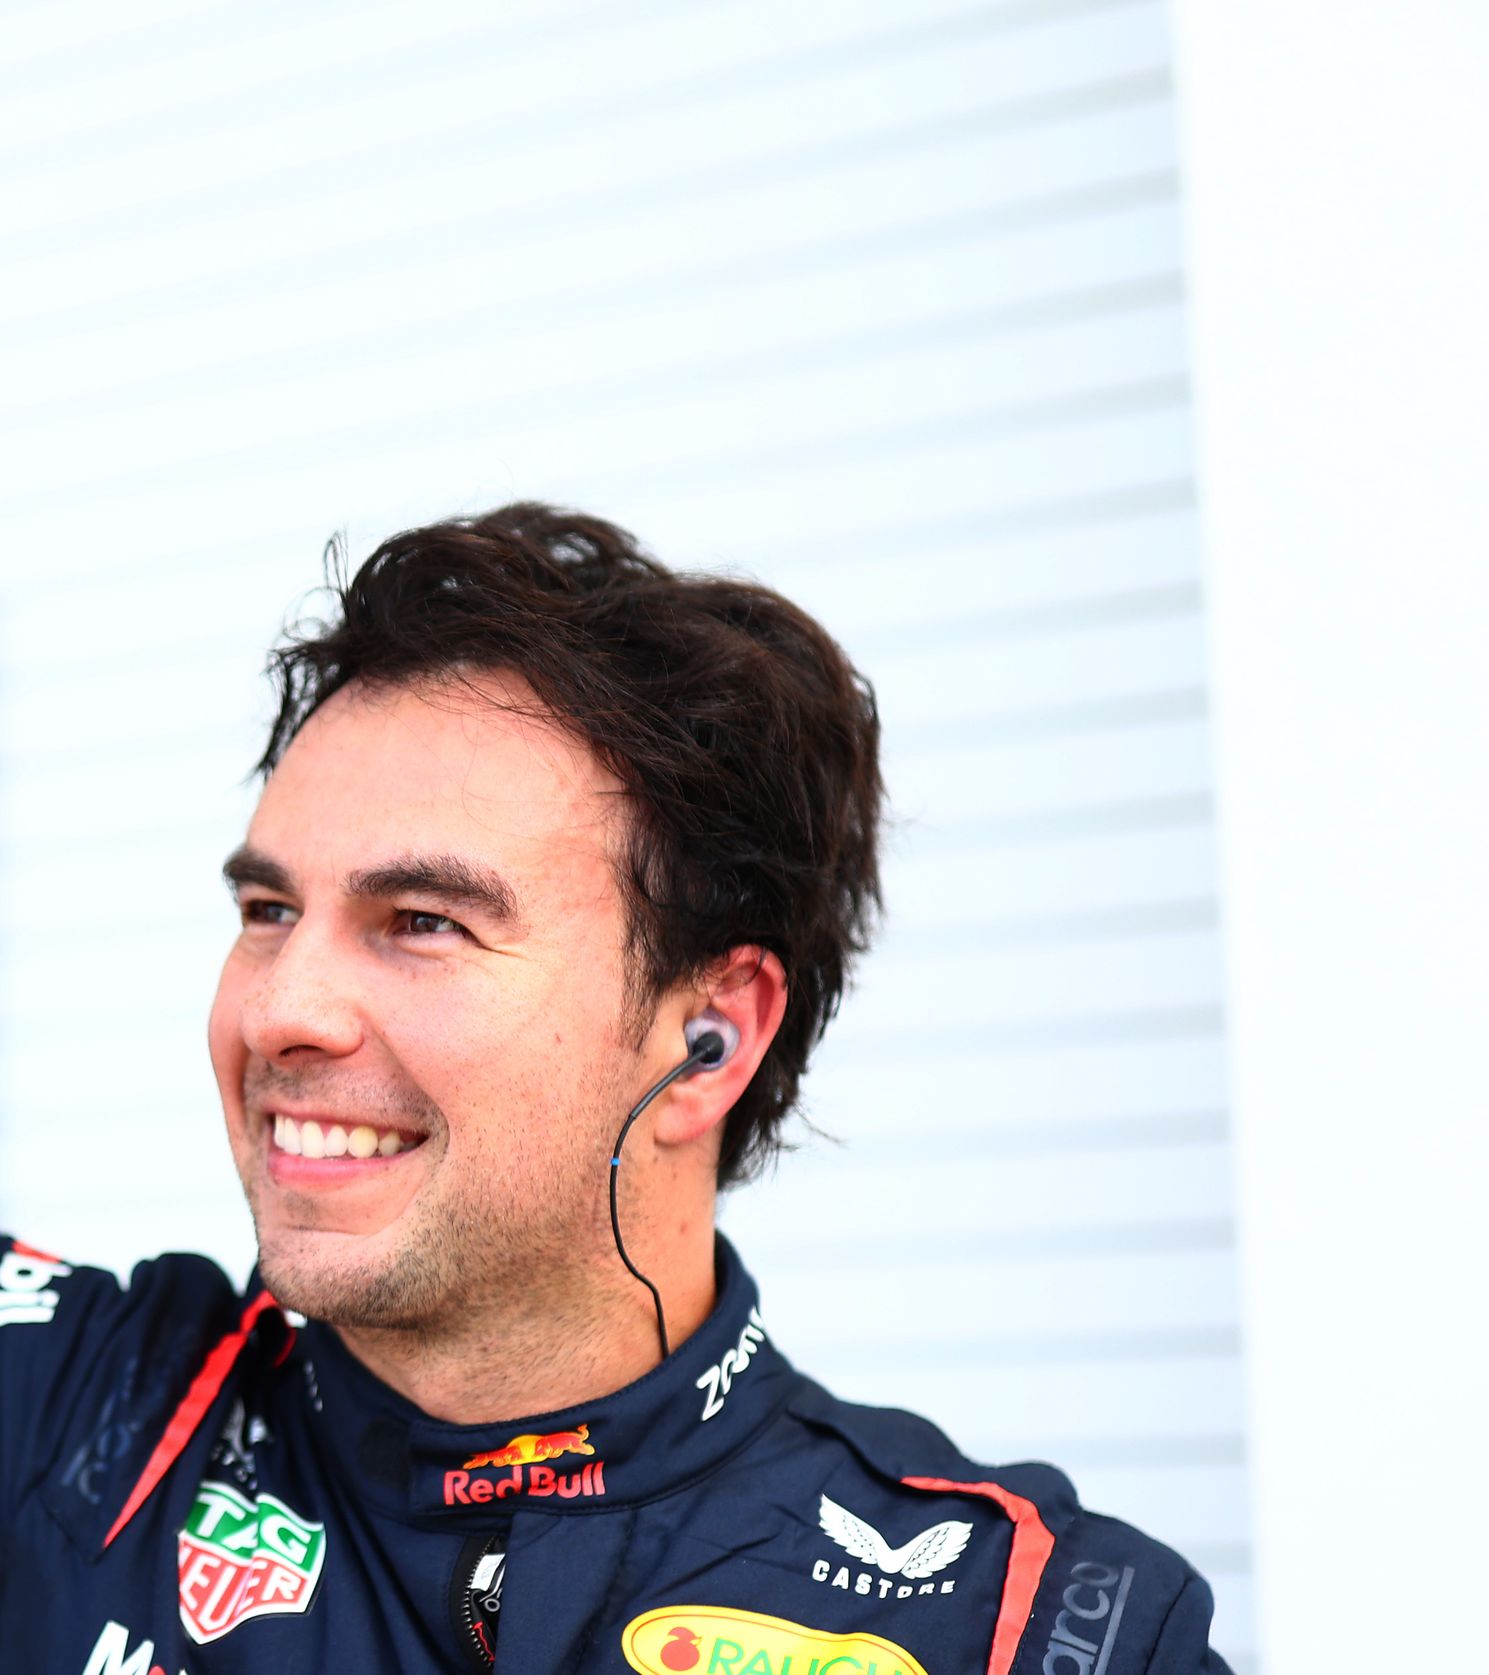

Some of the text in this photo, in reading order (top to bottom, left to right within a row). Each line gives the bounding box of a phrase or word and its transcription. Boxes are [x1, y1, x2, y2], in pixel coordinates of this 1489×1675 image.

[443, 1461, 606, 1505] Red Bull
[196, 1492, 312, 1566] TAG
[812, 1559, 956, 1599] CASTORE
